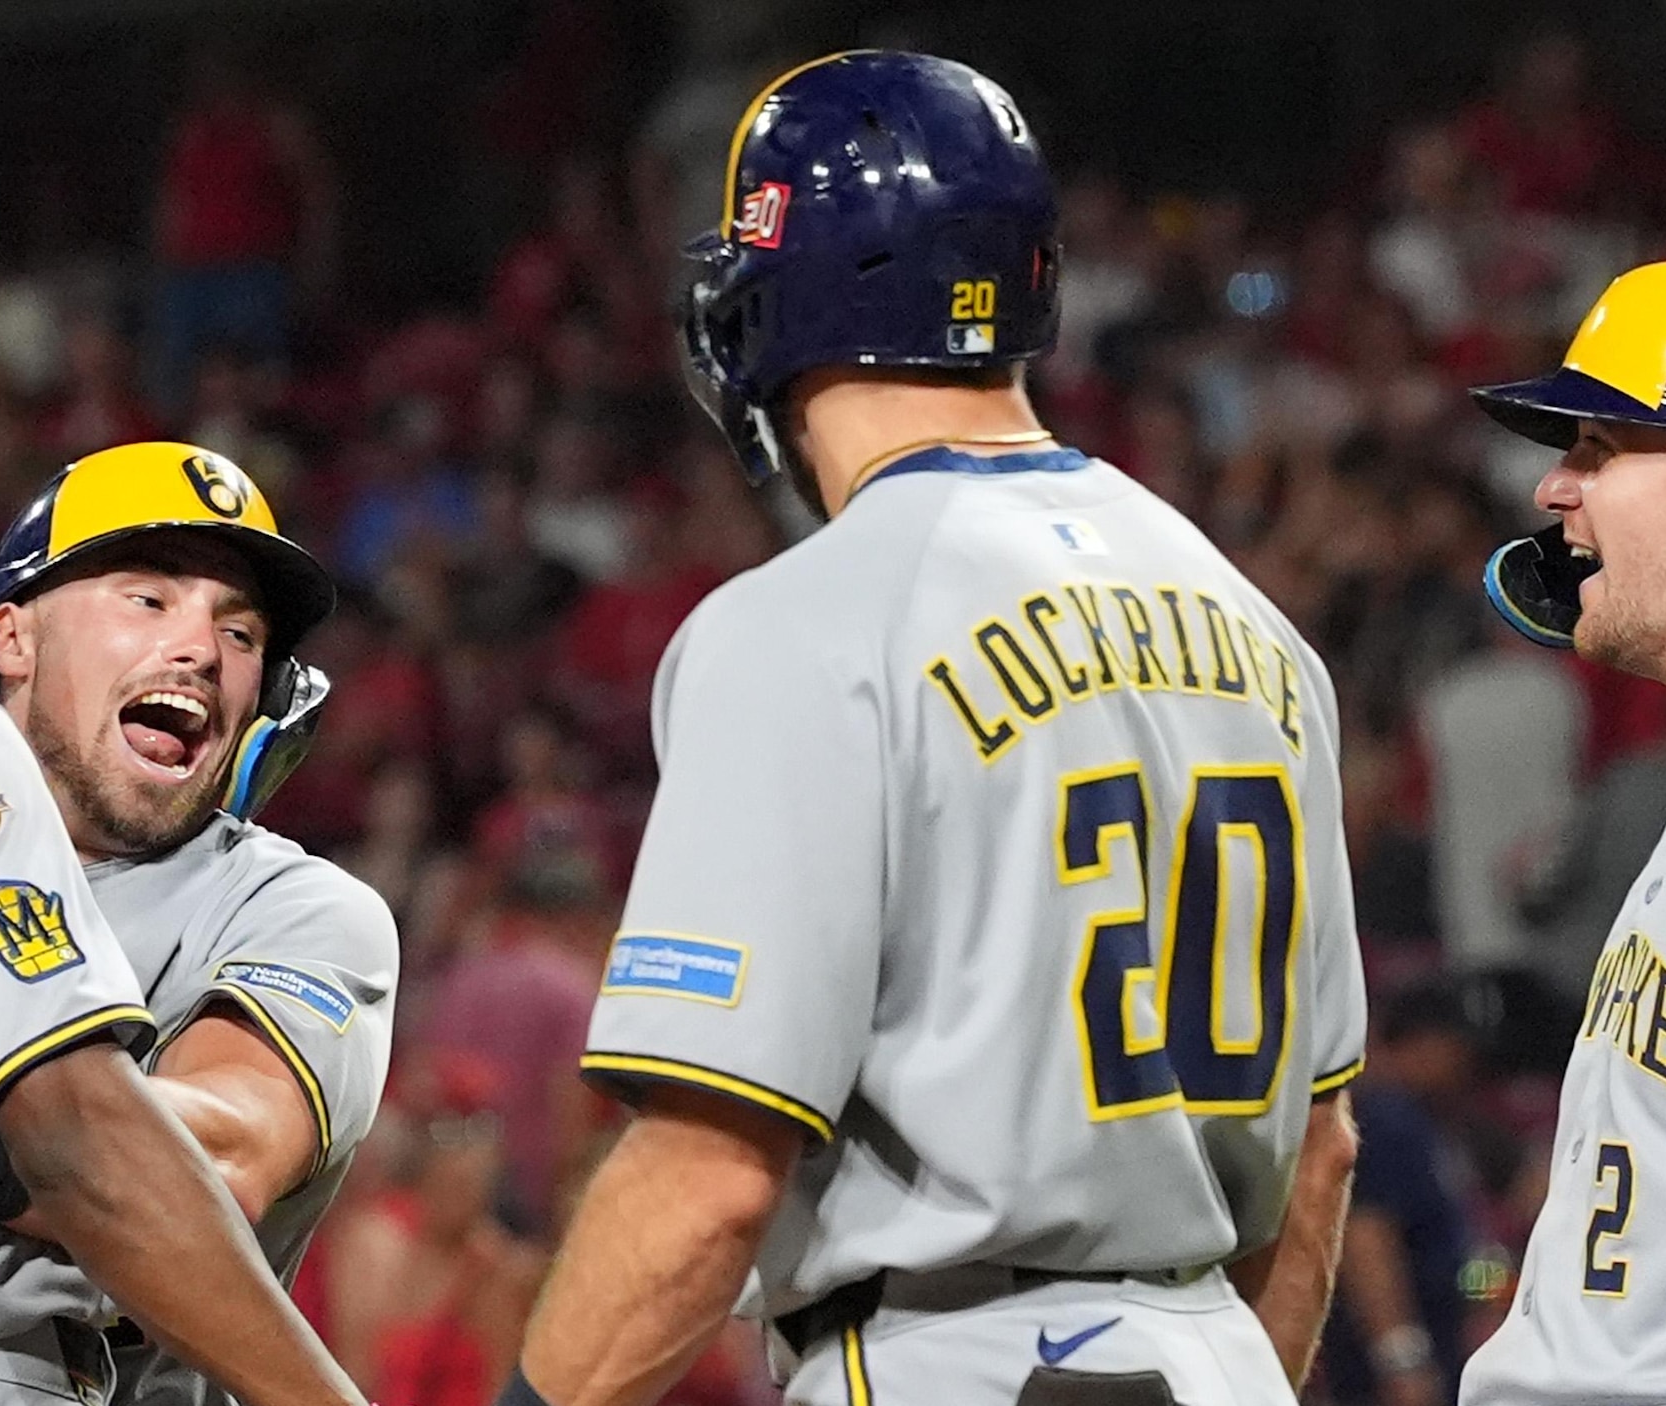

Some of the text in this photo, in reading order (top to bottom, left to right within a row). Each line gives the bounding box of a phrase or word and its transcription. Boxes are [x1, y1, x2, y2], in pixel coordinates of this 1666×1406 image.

[951, 280, 995, 320] 20
[248, 972, 304, 995] Mutual
[1053, 760, 1304, 1123] 20
[1582, 1139, 1635, 1298] 2
